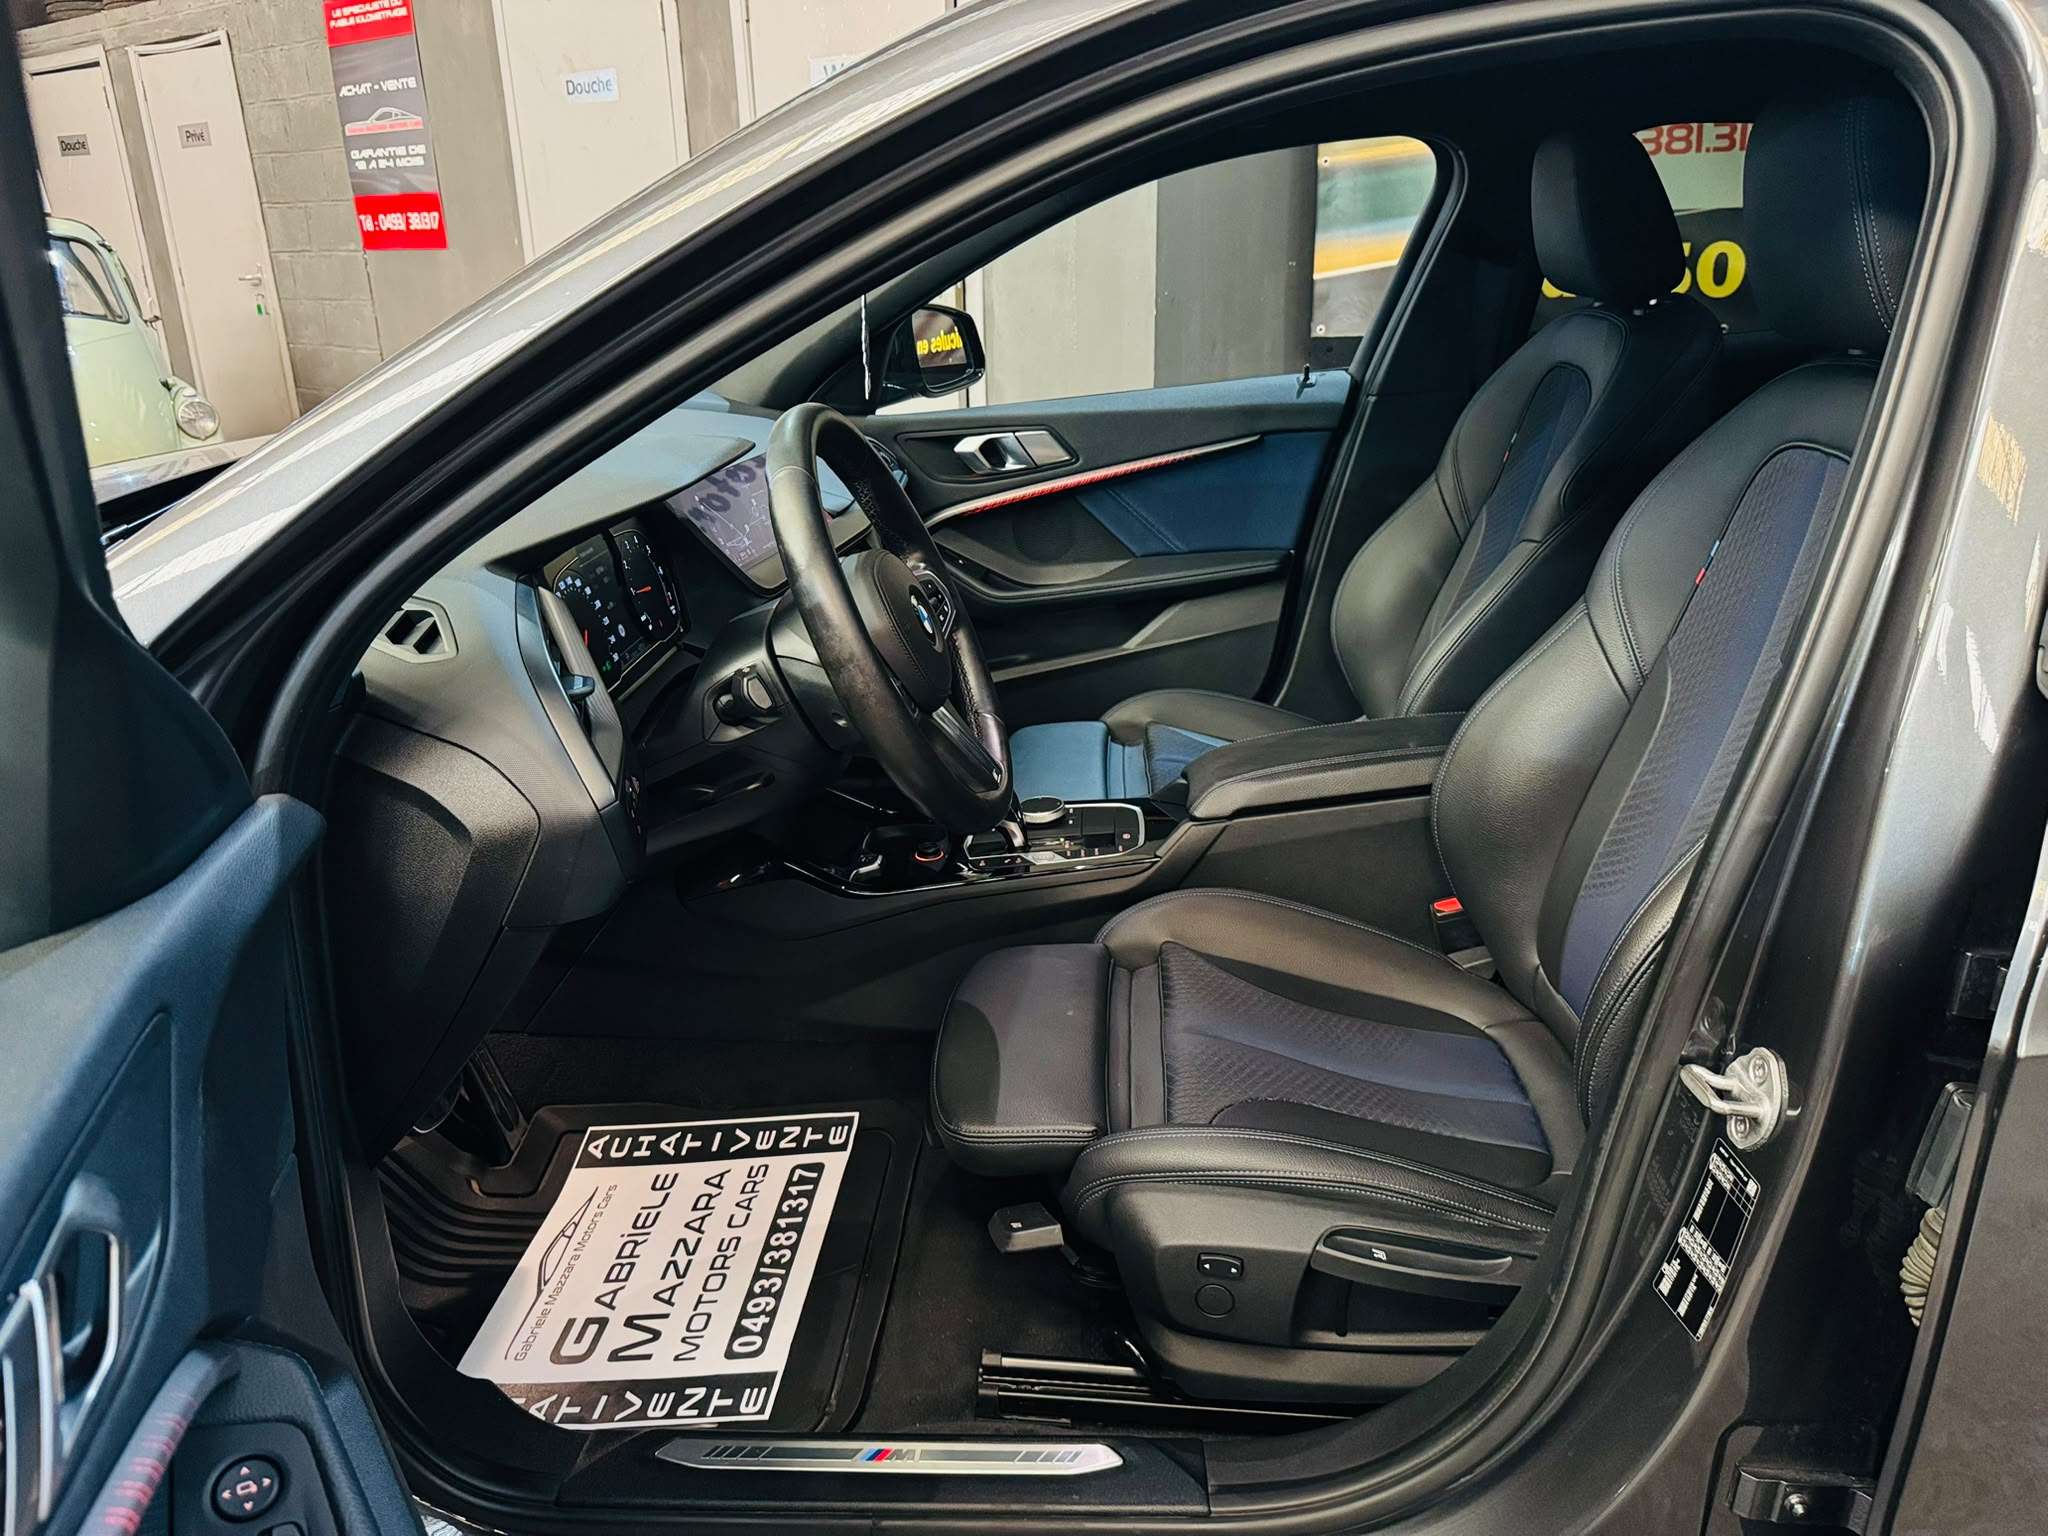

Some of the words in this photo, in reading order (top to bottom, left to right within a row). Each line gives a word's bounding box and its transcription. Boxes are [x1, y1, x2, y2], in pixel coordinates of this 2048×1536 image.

[339, 82, 372, 97] ACHAT
[380, 76, 417, 91] VENTE
[565, 76, 613, 96] Douche
[60, 140, 87, 151] Douche
[350, 146, 408, 159] GARANTIE
[408, 144, 427, 155] DE
[395, 156, 425, 168] MOIS
[607, 1168, 733, 1362] MAZZARA
[673, 1236, 742, 1362] MOTORS
[727, 1164, 769, 1229] CARS
[731, 1168, 819, 1353] 0493/381317
[514, 1308, 552, 1361] Gabriele
[544, 1254, 581, 1306] Mazzara
[573, 1211, 603, 1252] Motors
